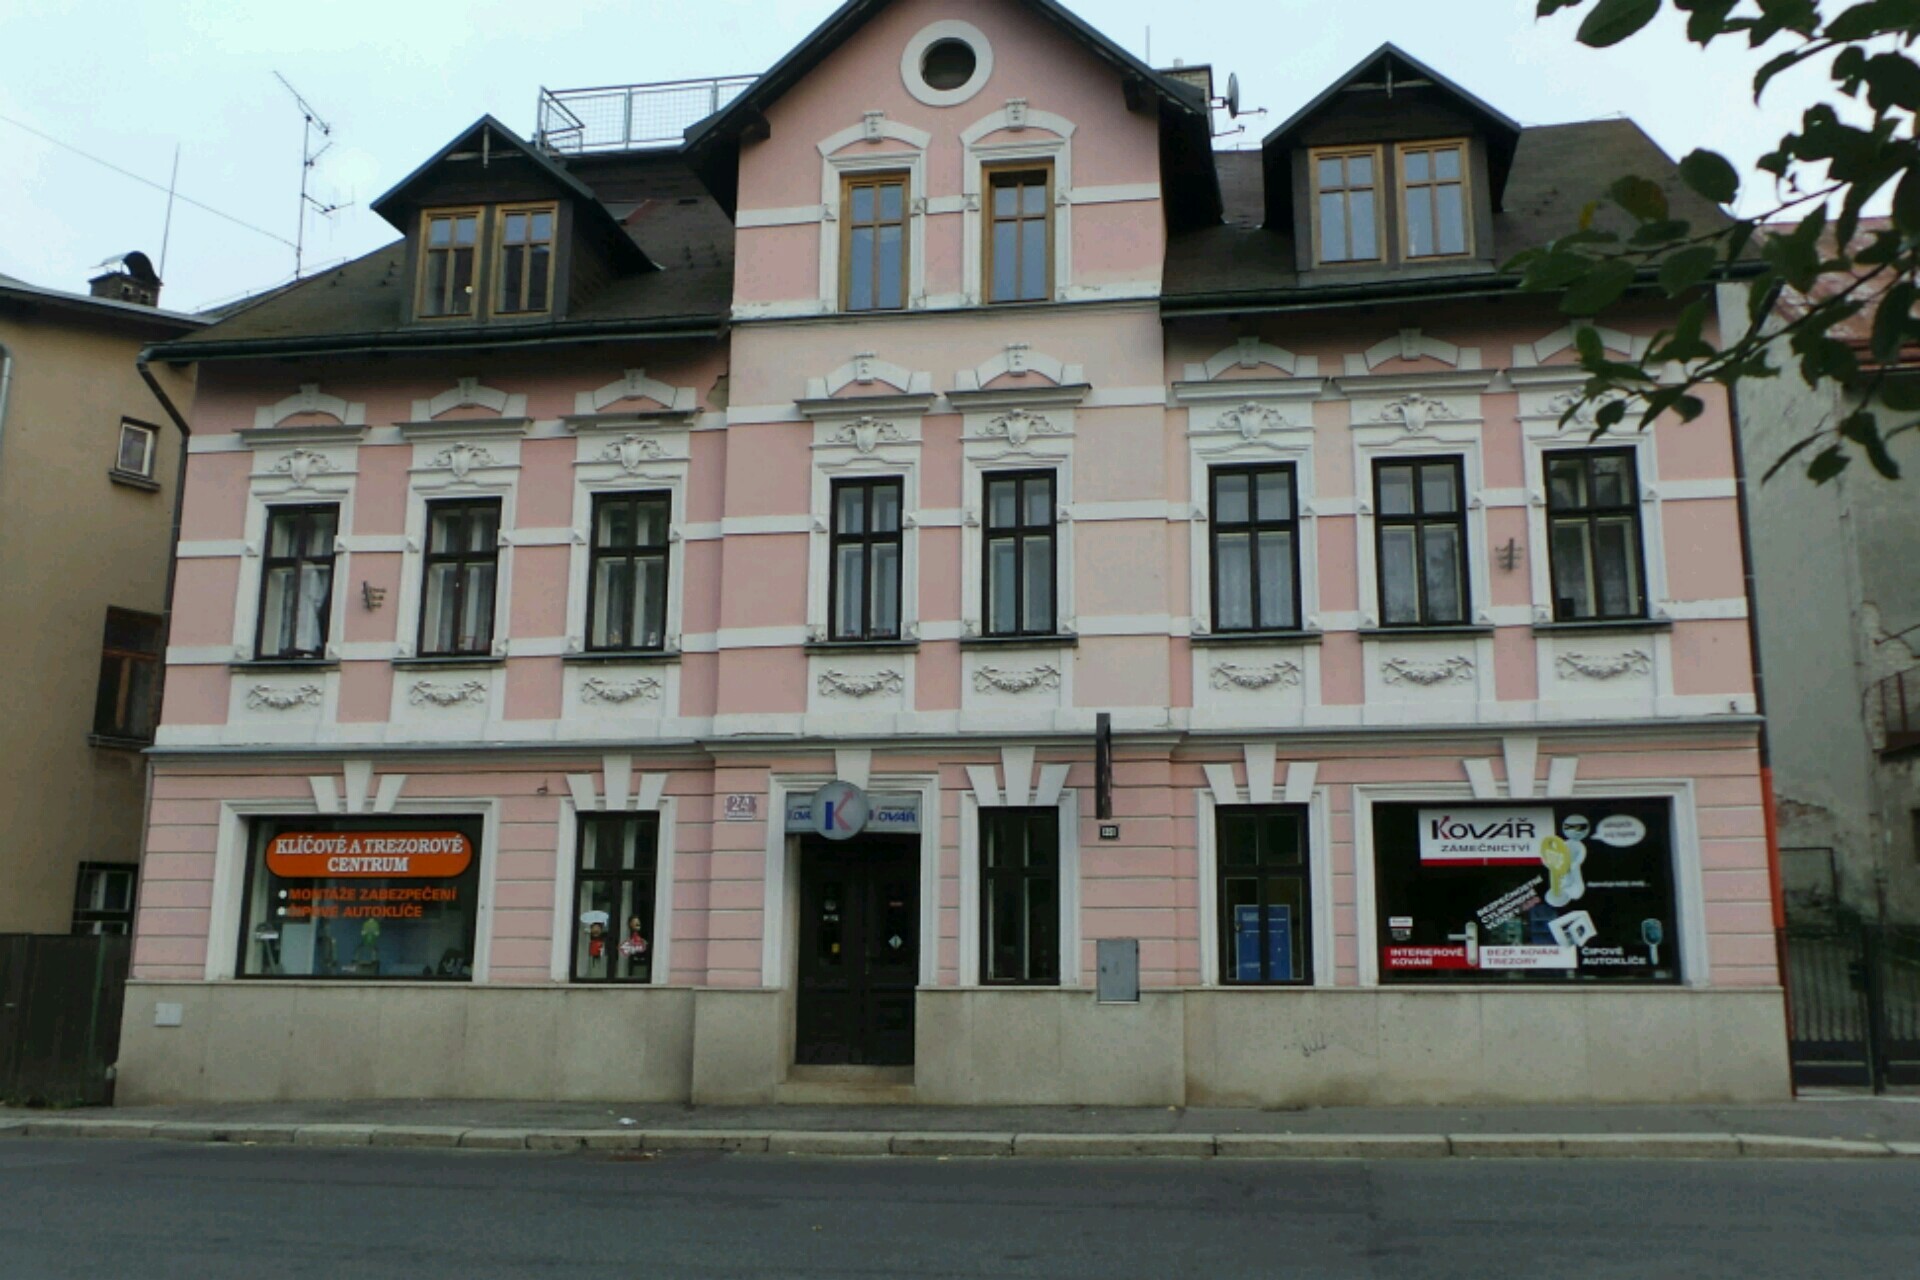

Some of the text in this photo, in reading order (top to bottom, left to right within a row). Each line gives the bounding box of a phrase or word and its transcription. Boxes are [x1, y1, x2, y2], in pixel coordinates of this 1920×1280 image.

[1431, 815, 1536, 840] KOVÁŘ
[275, 834, 464, 855] KLÍČOVÉ A TREZOROVÉ
[327, 857, 410, 873] CENTRUM
[290, 886, 457, 901] MONTÁŽE ZABEZPEČENÍ
[344, 903, 423, 918] AUTOKLÍČE
[1581, 955, 1647, 966] AUTOKLÍČE
